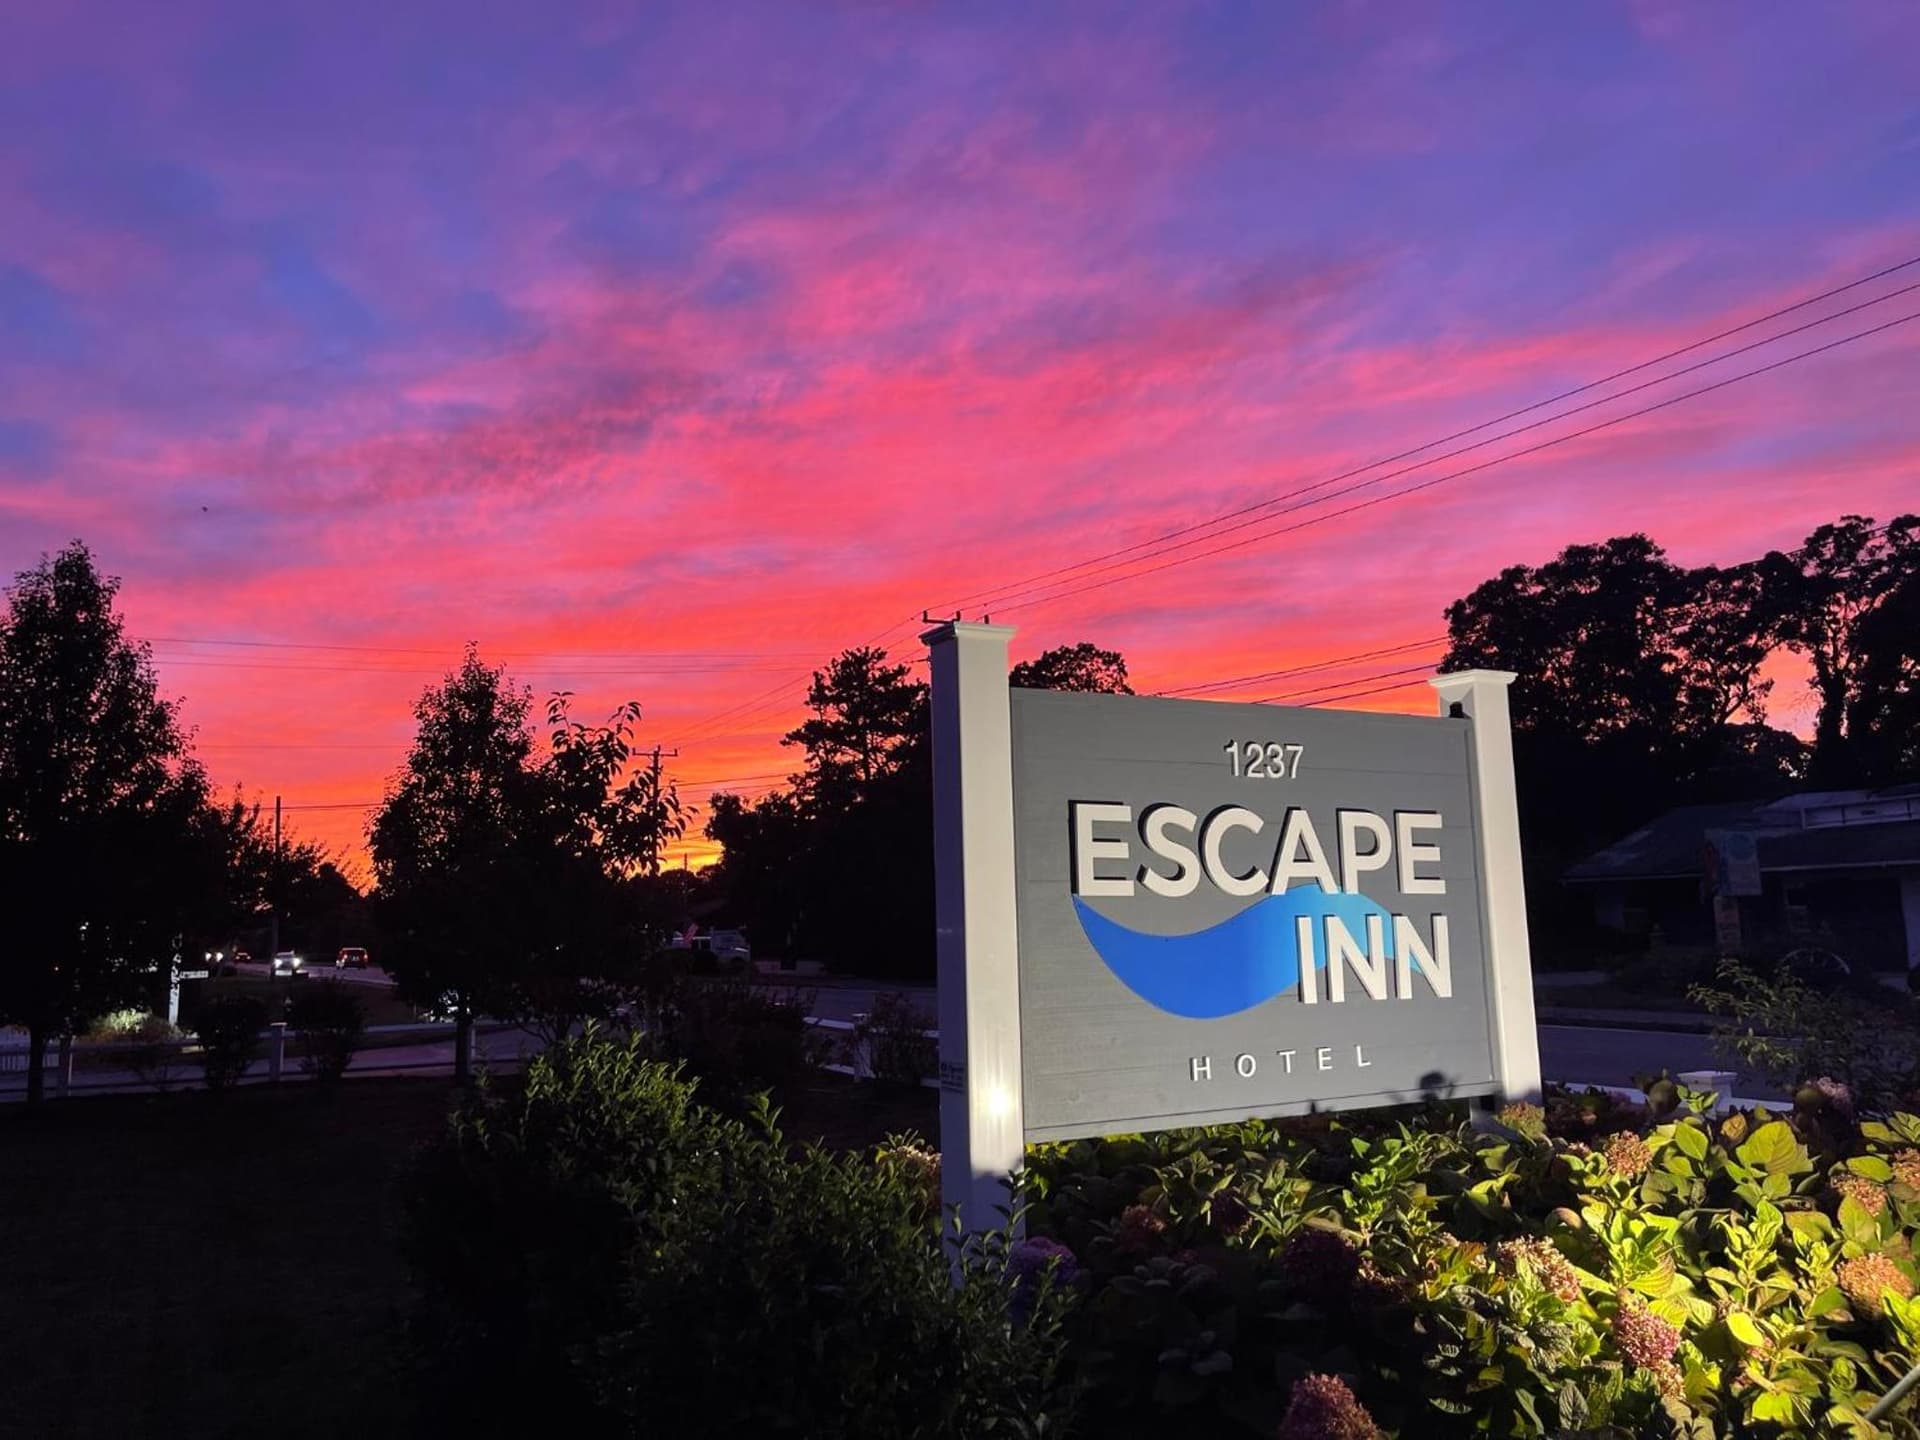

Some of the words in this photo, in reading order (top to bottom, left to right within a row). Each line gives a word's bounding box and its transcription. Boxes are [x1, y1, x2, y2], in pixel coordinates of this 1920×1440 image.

[1224, 740, 1304, 778] 1237
[1071, 802, 1447, 897] ESCAPE
[1296, 914, 1453, 1004] INN
[1191, 1045, 1372, 1081] HOTEL
